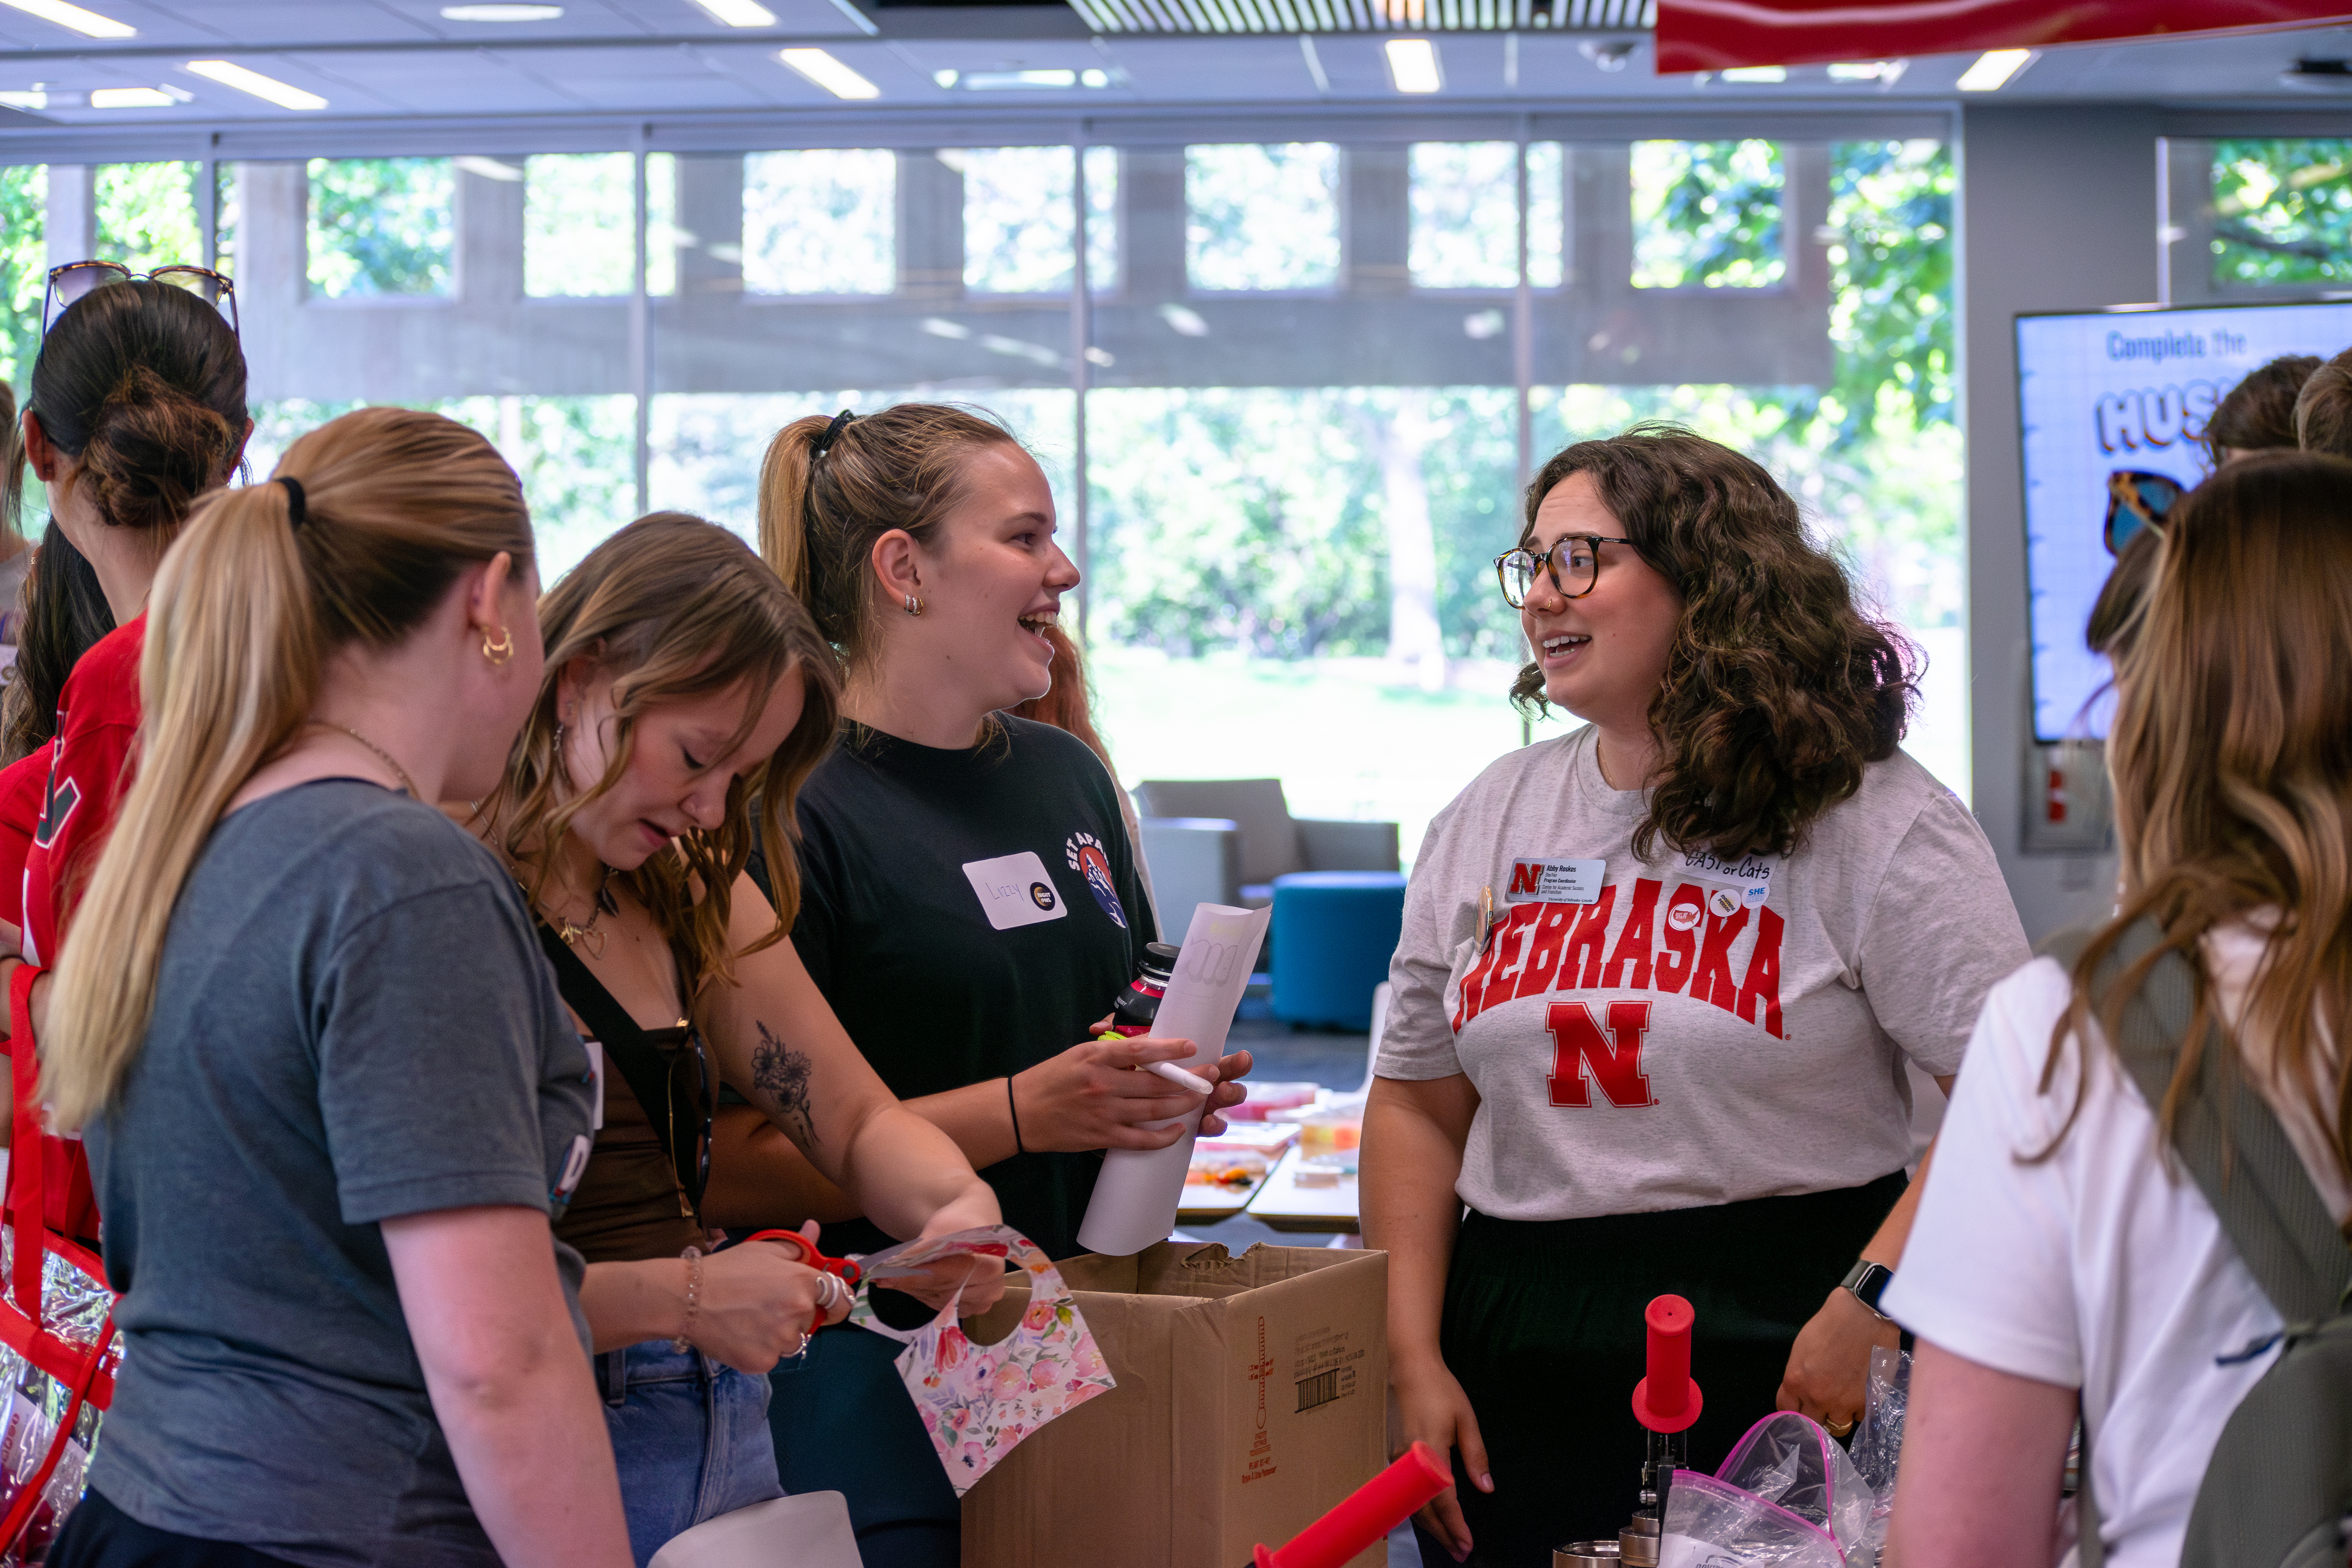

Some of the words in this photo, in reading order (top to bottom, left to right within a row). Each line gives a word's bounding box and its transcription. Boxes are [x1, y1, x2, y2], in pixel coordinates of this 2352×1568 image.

[2107, 328, 2206, 364] Complete
[2213, 328, 2246, 356] the
[1066, 837, 1080, 871] SET
[1075, 832, 1112, 876] APA
[1739, 856, 1770, 879] Cats
[1509, 863, 1545, 895] N
[1748, 887, 1766, 896] SHE
[1452, 878, 1785, 1040] NEBRASKA
[1545, 1000, 1653, 1109] N
